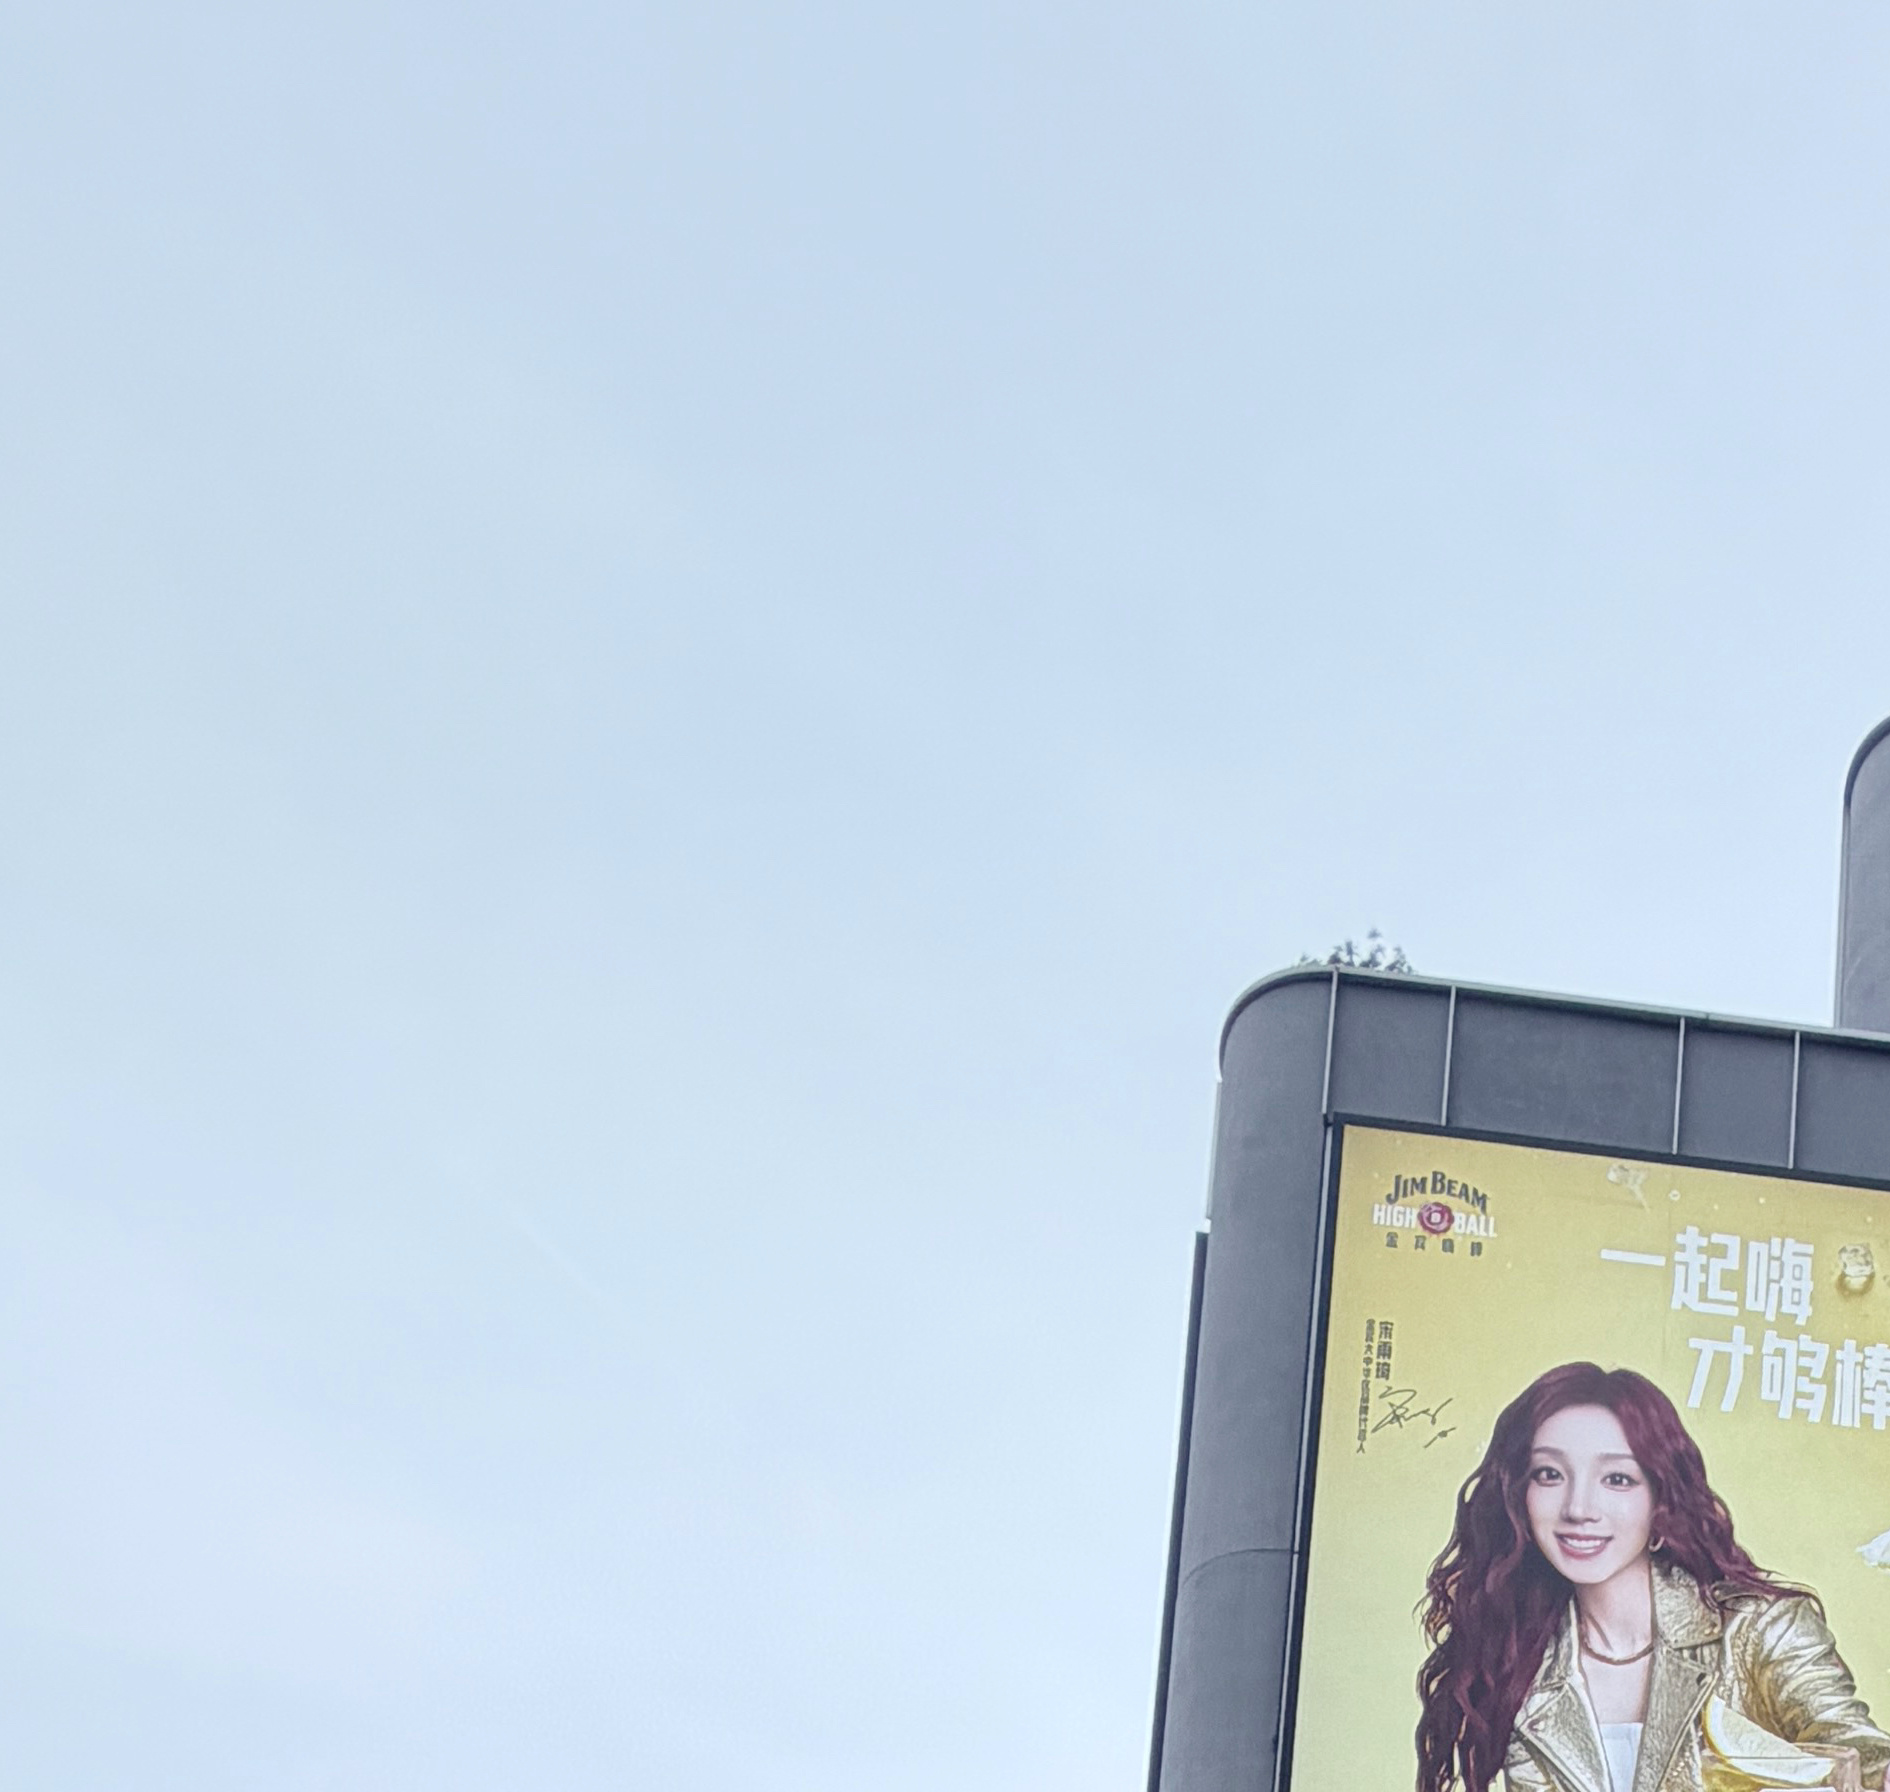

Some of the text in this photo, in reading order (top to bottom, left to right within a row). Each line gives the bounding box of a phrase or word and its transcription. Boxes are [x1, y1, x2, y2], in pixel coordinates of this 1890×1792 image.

[1385, 1170, 1488, 1215] JIM BEAM
[1372, 1203, 1498, 1238] HIGH BALL
[1600, 1225, 1814, 1326] 一起嗨
